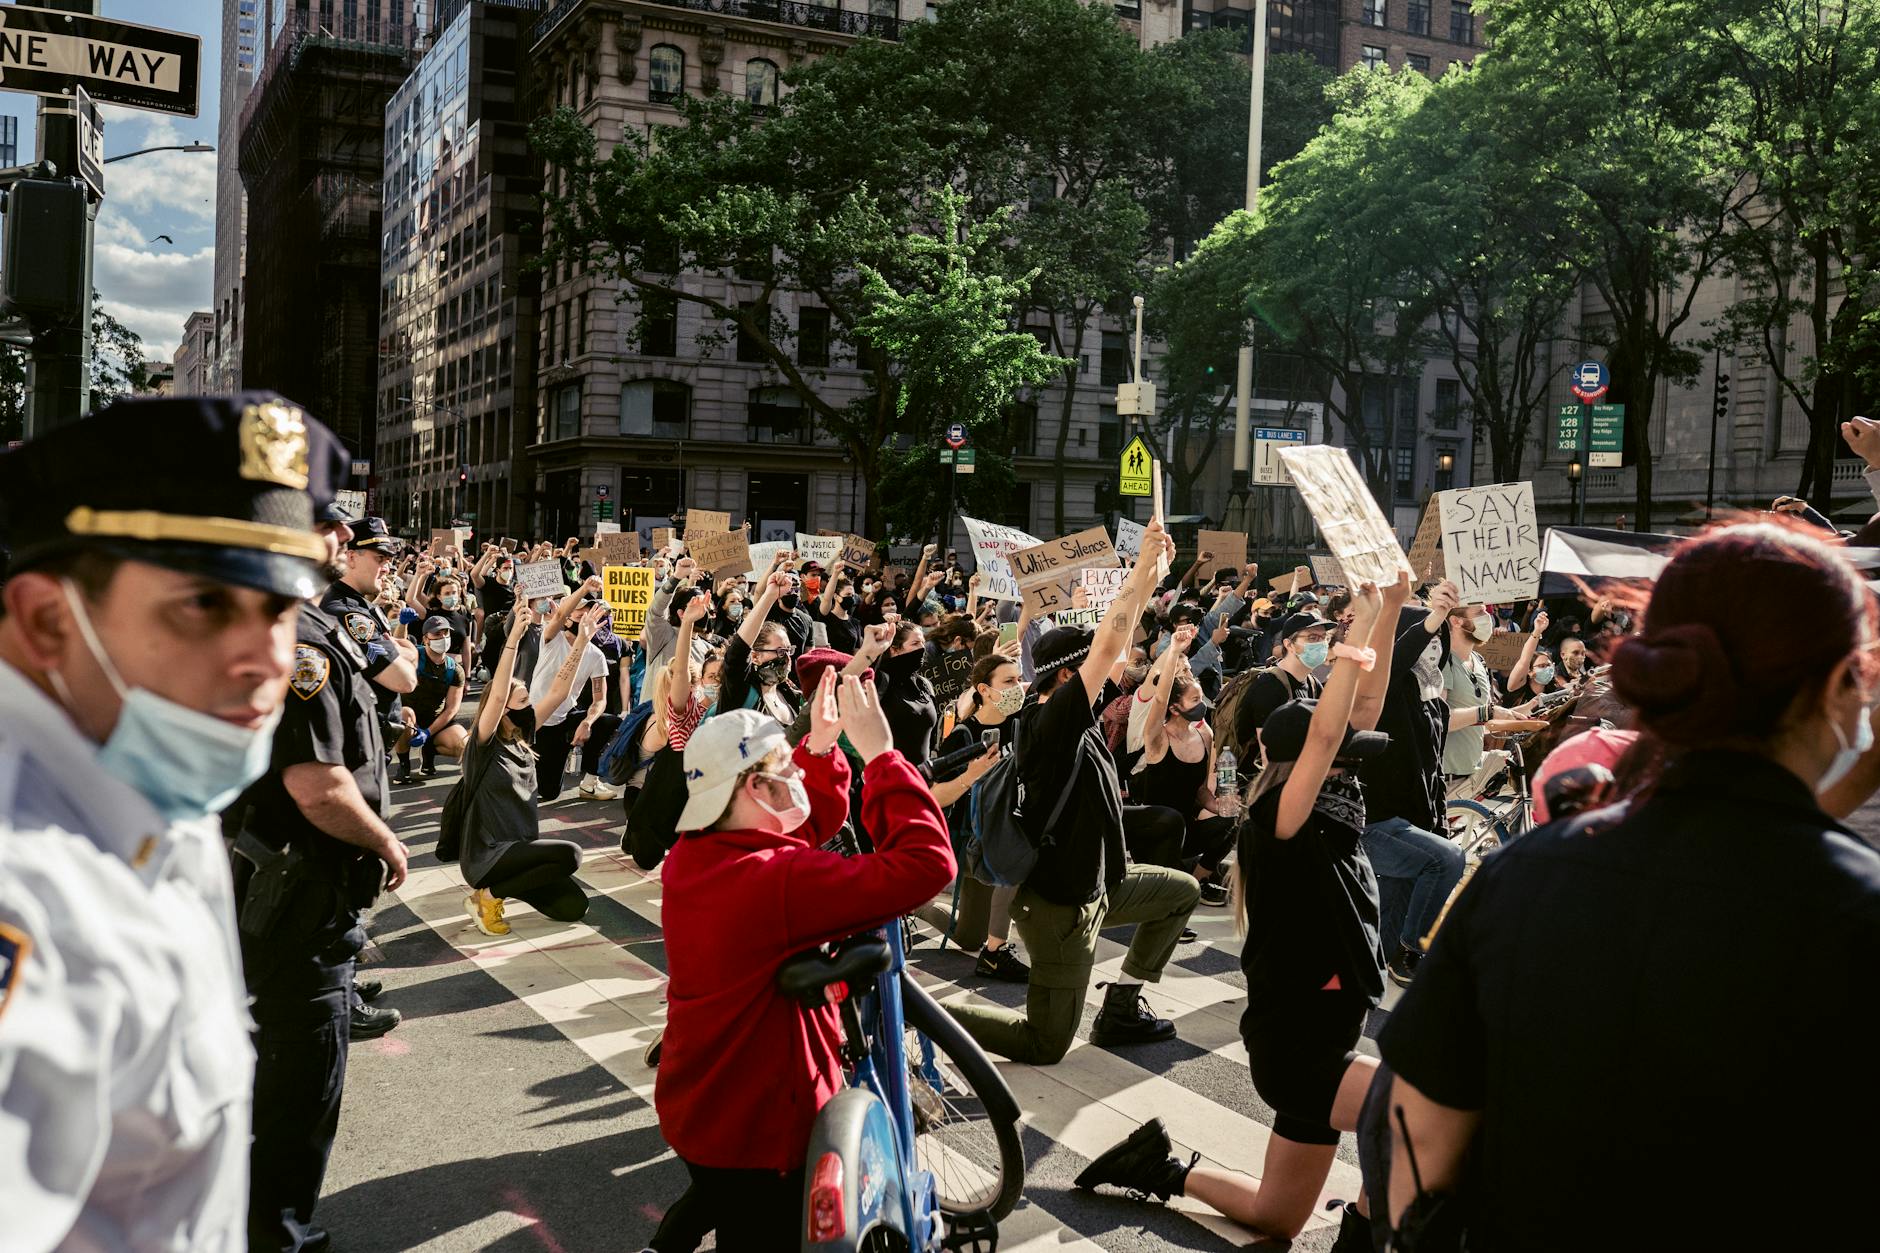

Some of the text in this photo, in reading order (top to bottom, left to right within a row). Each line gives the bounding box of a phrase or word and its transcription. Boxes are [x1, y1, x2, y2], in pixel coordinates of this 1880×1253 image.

[0, 32, 165, 84] NE WAY
[1561, 405, 1579, 415] x27
[1560, 417, 1578, 427] x28
[1560, 429, 1578, 438] x37
[1559, 440, 1576, 450] x38
[1122, 482, 1149, 491] AHEAD
[1456, 489, 1523, 525] SAY
[604, 536, 634, 547] BLACK
[802, 540, 836, 549] NO JUSTICE
[979, 541, 1000, 549] END
[1448, 524, 1538, 554] THEIR
[610, 546, 632, 554] LIVES
[812, 551, 831, 559] PEACE
[843, 546, 870, 564] NOW
[889, 555, 919, 567] verizo
[1019, 551, 1060, 576] White
[1060, 539, 1109, 560] Silence
[983, 559, 999, 573] NO
[608, 571, 650, 587] BLACK
[1086, 569, 1130, 586] BLACK
[1459, 556, 1541, 592] NAMES
[529, 579, 560, 589] VIOLENCE
[989, 577, 1007, 594] NO
[610, 589, 648, 604] LIVES
[1032, 586, 1058, 609] Is
[944, 655, 973, 676] FOR
[934, 678, 959, 695] RGE,
